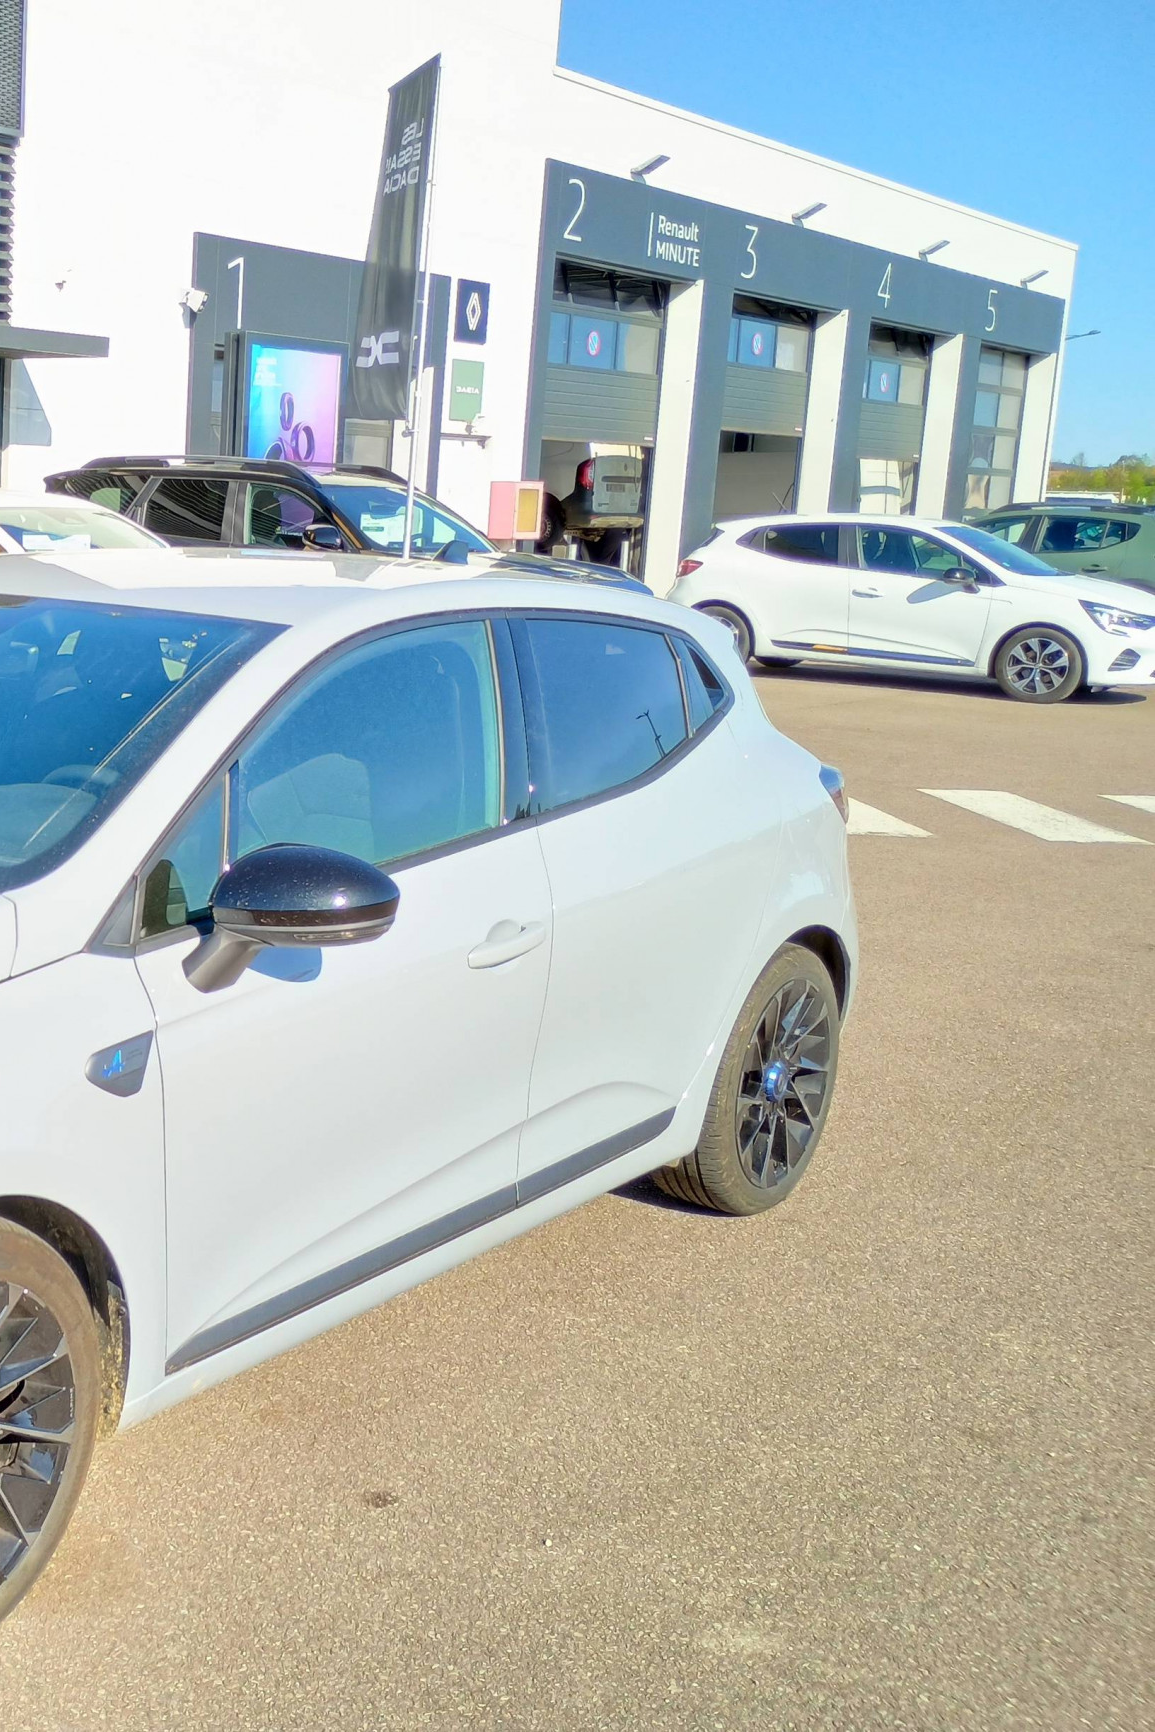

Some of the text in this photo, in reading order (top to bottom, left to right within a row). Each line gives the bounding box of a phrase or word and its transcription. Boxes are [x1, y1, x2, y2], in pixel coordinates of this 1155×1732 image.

[562, 178, 586, 242] 2
[657, 214, 700, 242] Renault
[655, 240, 701, 267] MINUTE
[739, 224, 759, 280] 3
[227, 256, 245, 330] 1
[876, 262, 893, 309] 4
[984, 289, 999, 332] 5
